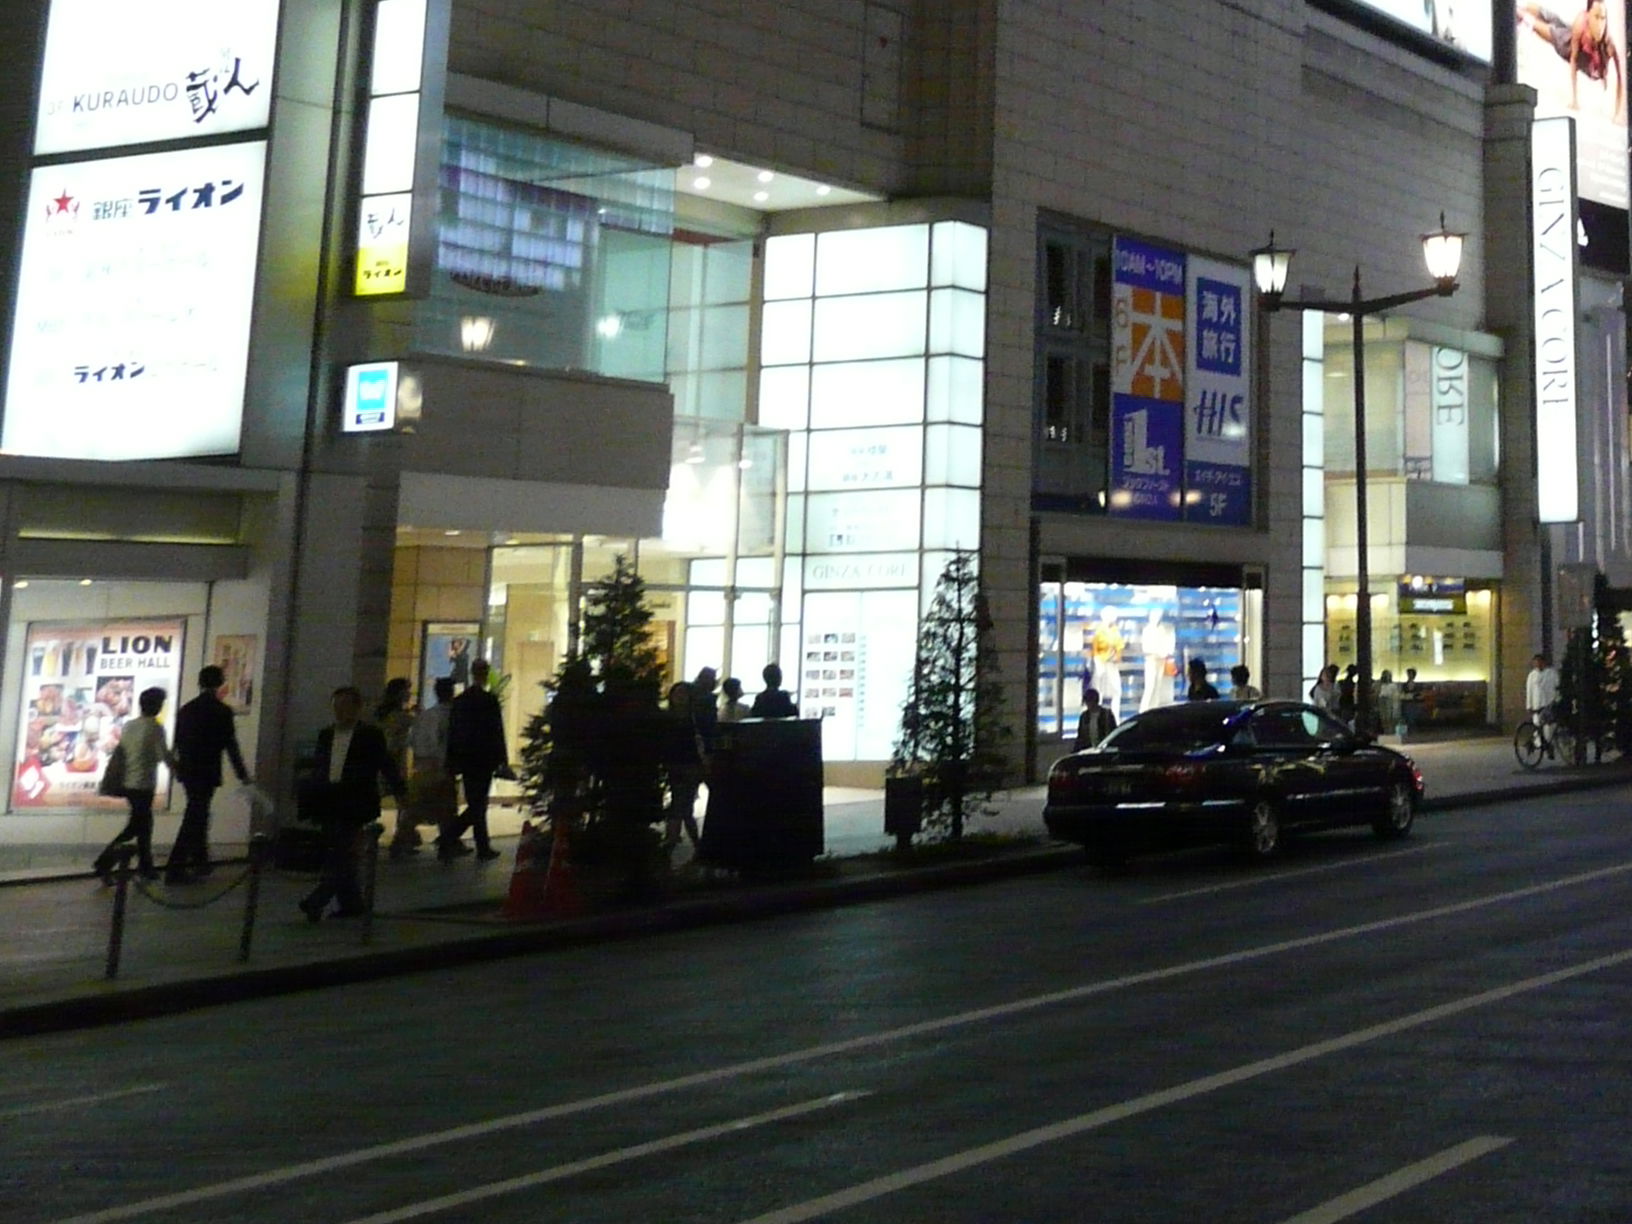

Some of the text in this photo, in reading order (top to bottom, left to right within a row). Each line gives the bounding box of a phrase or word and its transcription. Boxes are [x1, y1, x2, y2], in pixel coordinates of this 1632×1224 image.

[72, 84, 179, 113] KURAUDO
[137, 179, 245, 215] ライオン
[73, 361, 146, 384] ライオン
[101, 635, 173, 655] LION
[100, 655, 171, 670] BEER HALL
